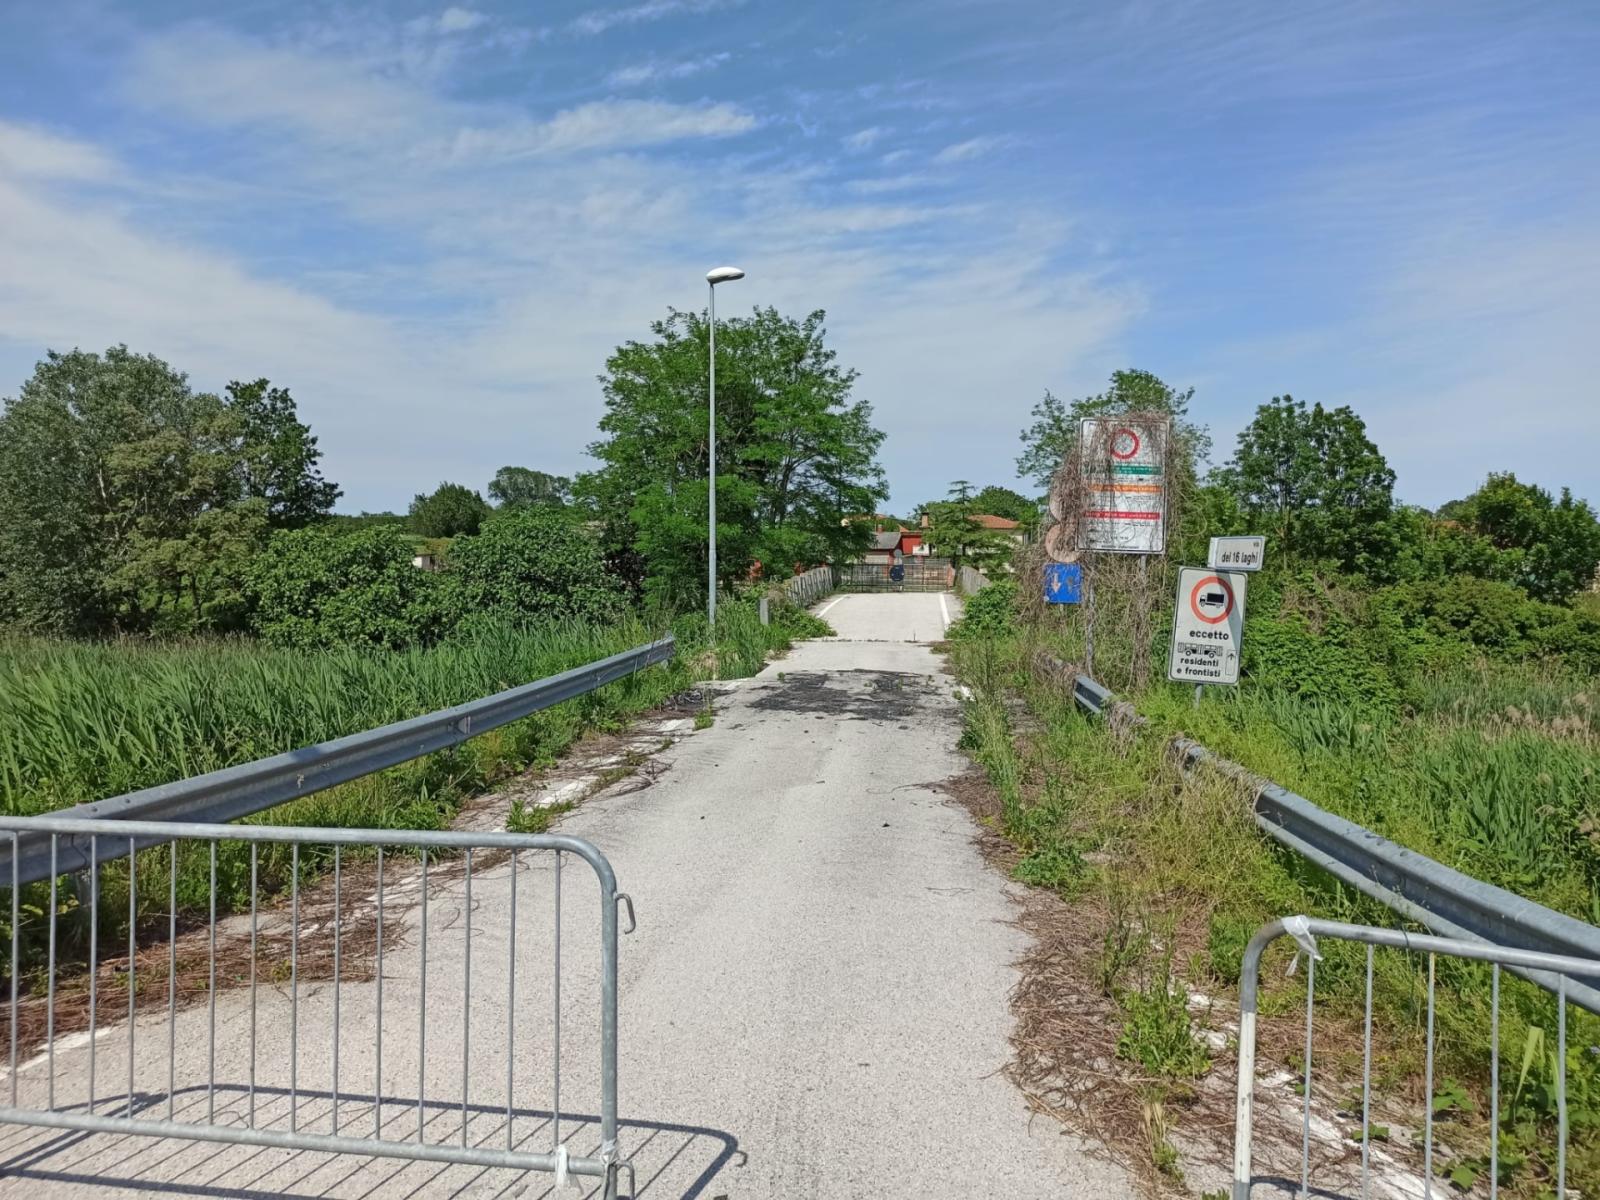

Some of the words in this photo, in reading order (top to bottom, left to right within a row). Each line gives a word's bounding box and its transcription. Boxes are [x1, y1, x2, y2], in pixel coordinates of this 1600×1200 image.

[1232, 551, 1240, 563] 16
[1241, 551, 1258, 565] laghi
[1189, 630, 1229, 640] eccetto
[1180, 657, 1219, 667] residenti
[1185, 666, 1221, 677] frontisti
